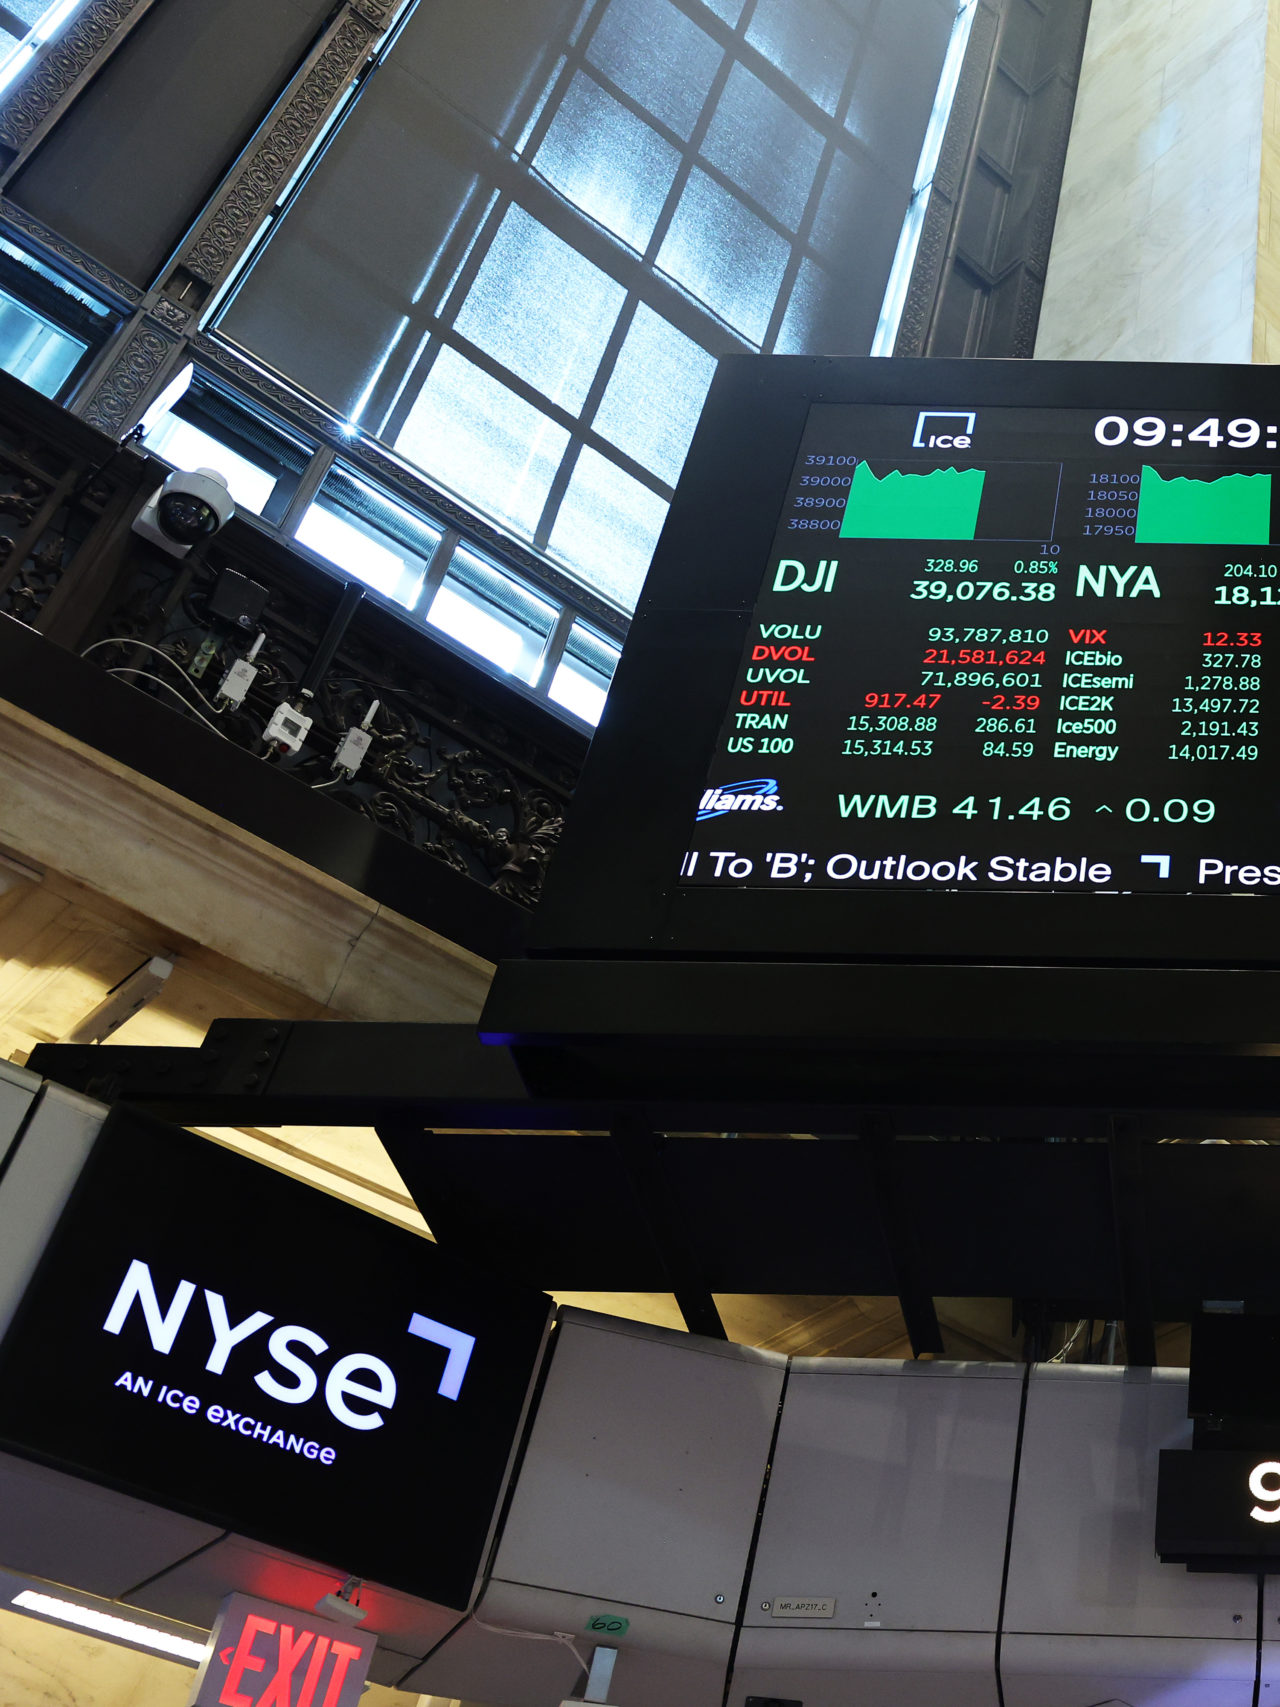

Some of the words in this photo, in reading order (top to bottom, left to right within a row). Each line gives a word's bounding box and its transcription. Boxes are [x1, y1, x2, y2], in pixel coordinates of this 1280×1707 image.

[806, 456, 856, 466] 39100
[800, 476, 851, 486] 39000
[1090, 474, 1140, 484] 18100
[794, 497, 846, 508] 38900
[1088, 490, 1138, 500] 18050
[1085, 508, 1136, 518] 18000
[788, 519, 840, 529] 38800
[1083, 525, 1135, 535] 17950
[1040, 544, 1060, 554] 10
[925, 559, 978, 572] 328.96
[1014, 561, 1057, 573] 0.85%
[1224, 564, 1277, 577] 204.10
[773, 560, 838, 592] DJI
[1076, 565, 1160, 598] NYA
[910, 581, 1055, 602] 39,076.38
[760, 624, 821, 639] VOLU
[929, 628, 1048, 644] 93,787,810
[1069, 629, 1107, 644] VIX
[1203, 632, 1262, 646] 12.33
[752, 646, 815, 661] DVOL
[923, 649, 1045, 666] 21,581,624
[1066, 651, 1122, 666] ICEbio
[1202, 654, 1261, 668] 327.78
[747, 668, 810, 683] UVOL
[922, 672, 1042, 688] 71,896,601
[1063, 673, 1133, 688] ICEsemi
[1185, 676, 1260, 691] 1,278.88
[740, 690, 791, 706] UTIL
[865, 693, 941, 708] 917.47
[982, 695, 1040, 710] -2.39
[1060, 696, 1114, 711] ICE2K
[1172, 698, 1259, 714] 13,497.72
[736, 713, 788, 729] TRAN
[847, 716, 937, 732] 15,308.88
[975, 718, 1036, 733] 286.61
[1057, 718, 1116, 734] Ice500
[1181, 721, 1258, 737] 2,191.43
[728, 737, 754, 752] US
[758, 738, 793, 753] 100
[842, 740, 933, 756] 15,314.53
[983, 742, 1033, 757] 84.59
[1054, 742, 1119, 761] Energy
[1169, 745, 1258, 761] 14,017.49
[839, 794, 937, 818] WMB
[952, 796, 1070, 821] 41.46
[1126, 798, 1215, 823] 0.09
[710, 852, 753, 878] To
[827, 854, 978, 881] Outlook
[988, 856, 1113, 882] Stable
[114, 1371, 154, 1398] AN
[219, 1614, 362, 1707] EXIT
